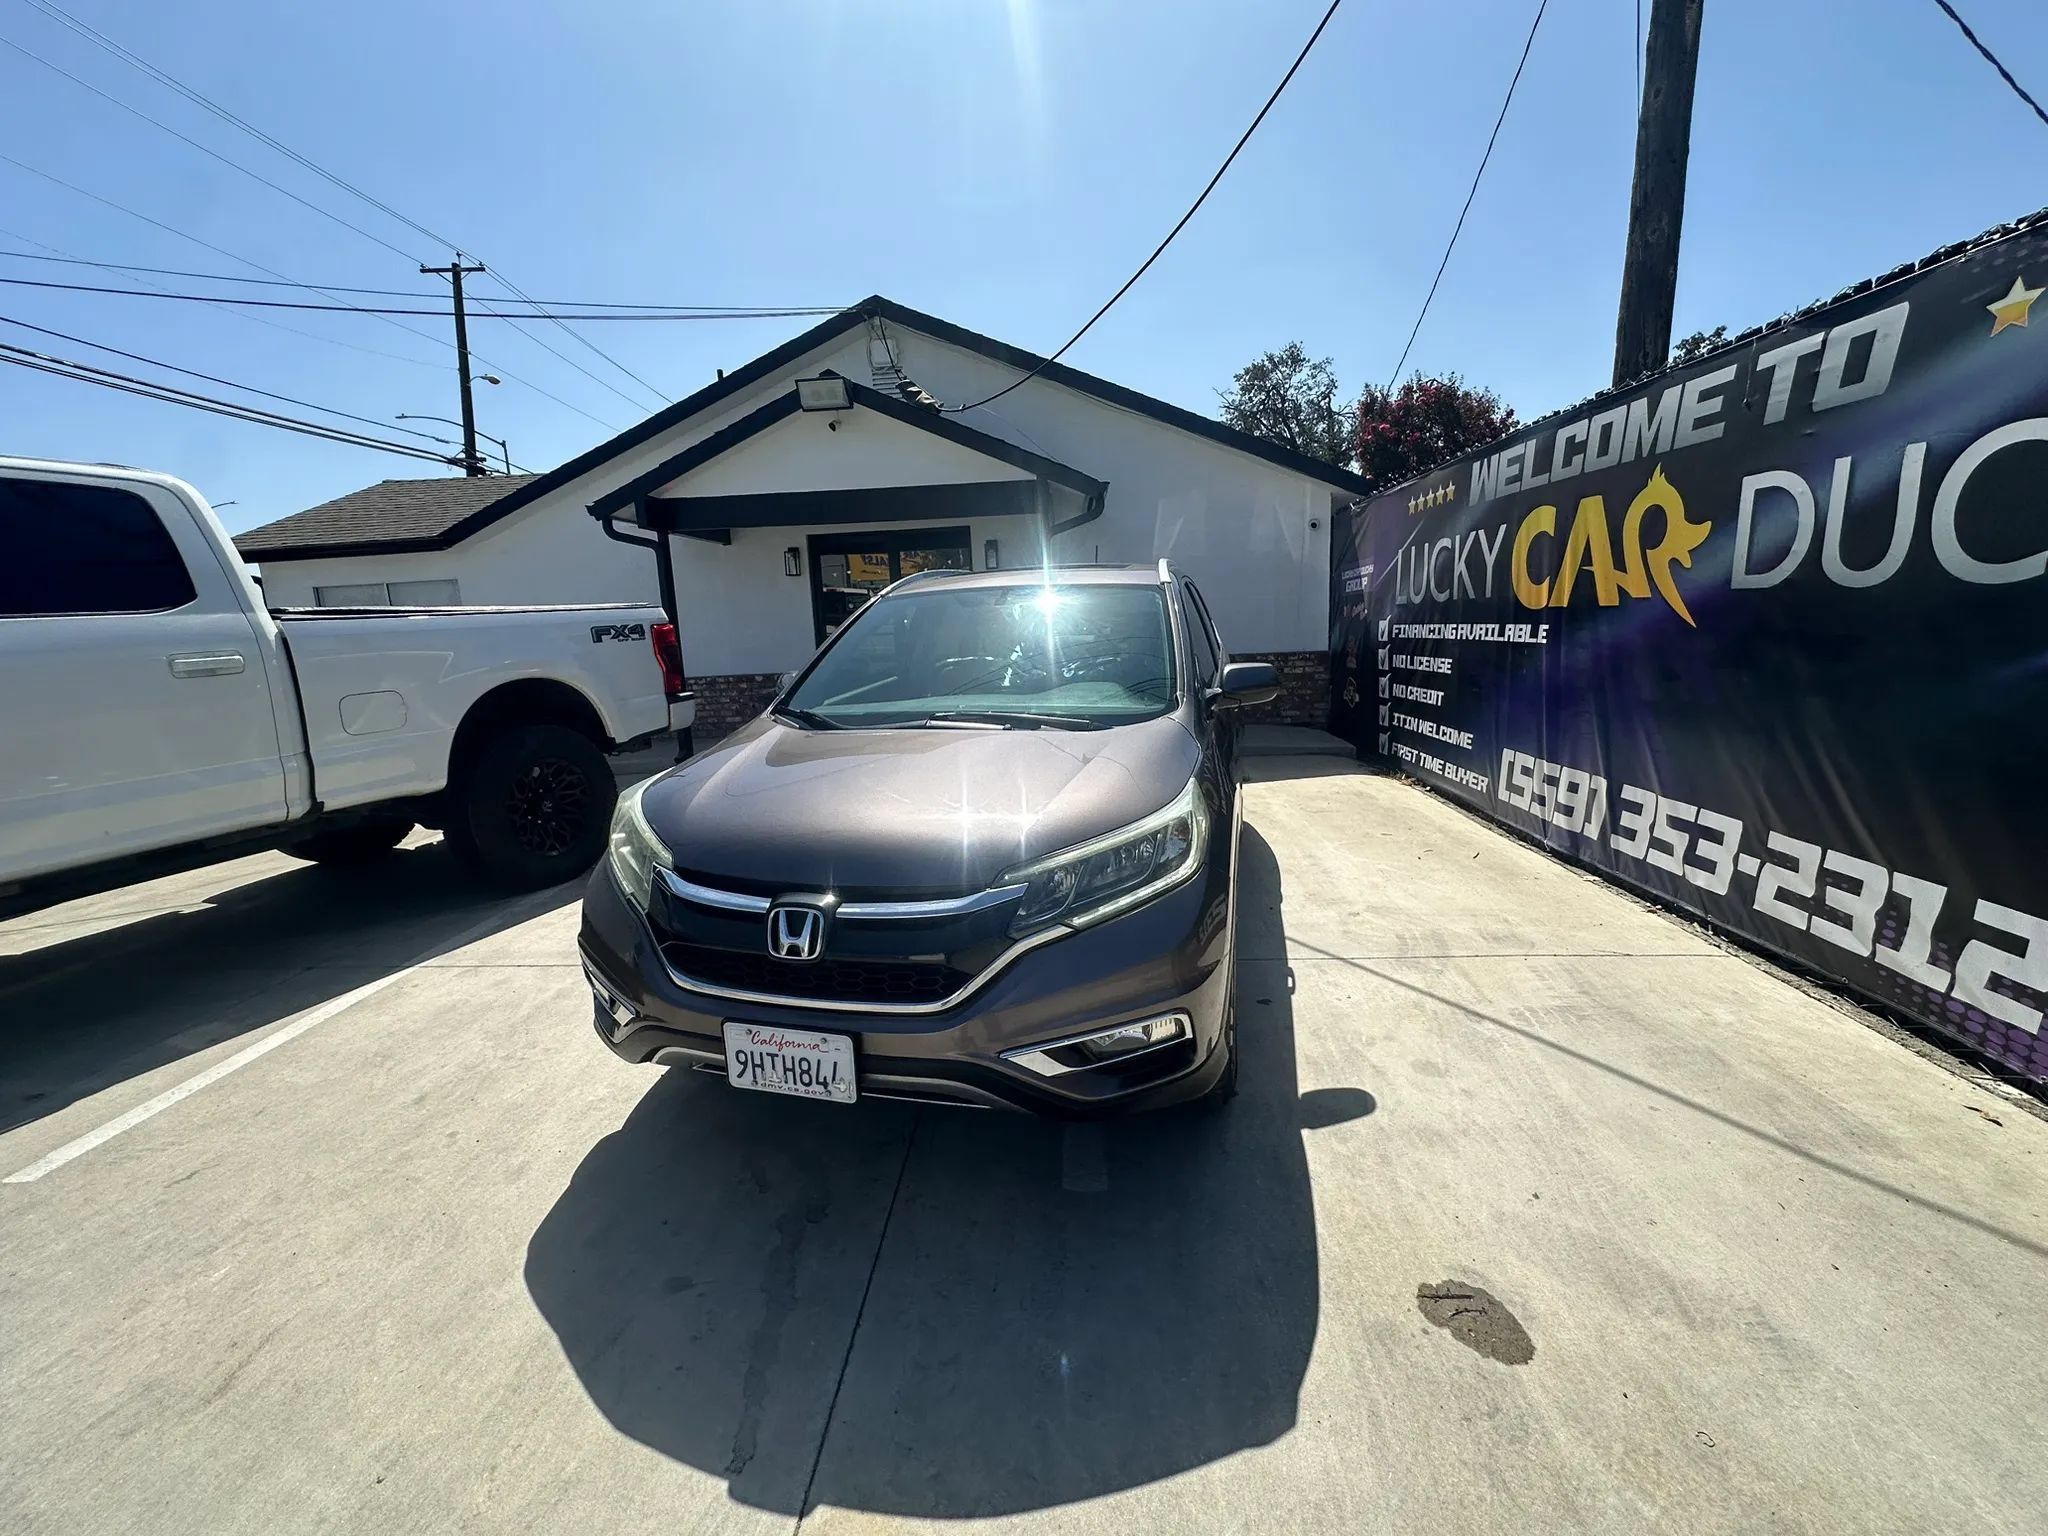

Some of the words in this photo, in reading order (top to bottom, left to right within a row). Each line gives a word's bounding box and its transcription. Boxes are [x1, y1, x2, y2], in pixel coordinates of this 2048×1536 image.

[1469, 365, 1737, 506] WELCOME
[1757, 301, 1909, 425] TO
[1395, 524, 1507, 605] LUCKY
[1512, 463, 1712, 628] CAR
[590, 624, 646, 643] FX4
[1391, 624, 1457, 639] FINANCING
[1458, 624, 1549, 644] AVAILABLE
[1392, 655, 1407, 668] NO
[1408, 655, 1452, 674] LICENSE
[1392, 684, 1407, 698] NO
[1408, 684, 1444, 706] CREDIT
[1392, 713, 1418, 730] ITIN
[1418, 719, 1474, 750] WELCOME
[1391, 742, 1418, 763] FIRST
[1419, 749, 1444, 774] TIME
[1444, 761, 1488, 793] BUYER
[1610, 784, 2048, 1035] 353-2312
[751, 1030, 829, 1053] California
